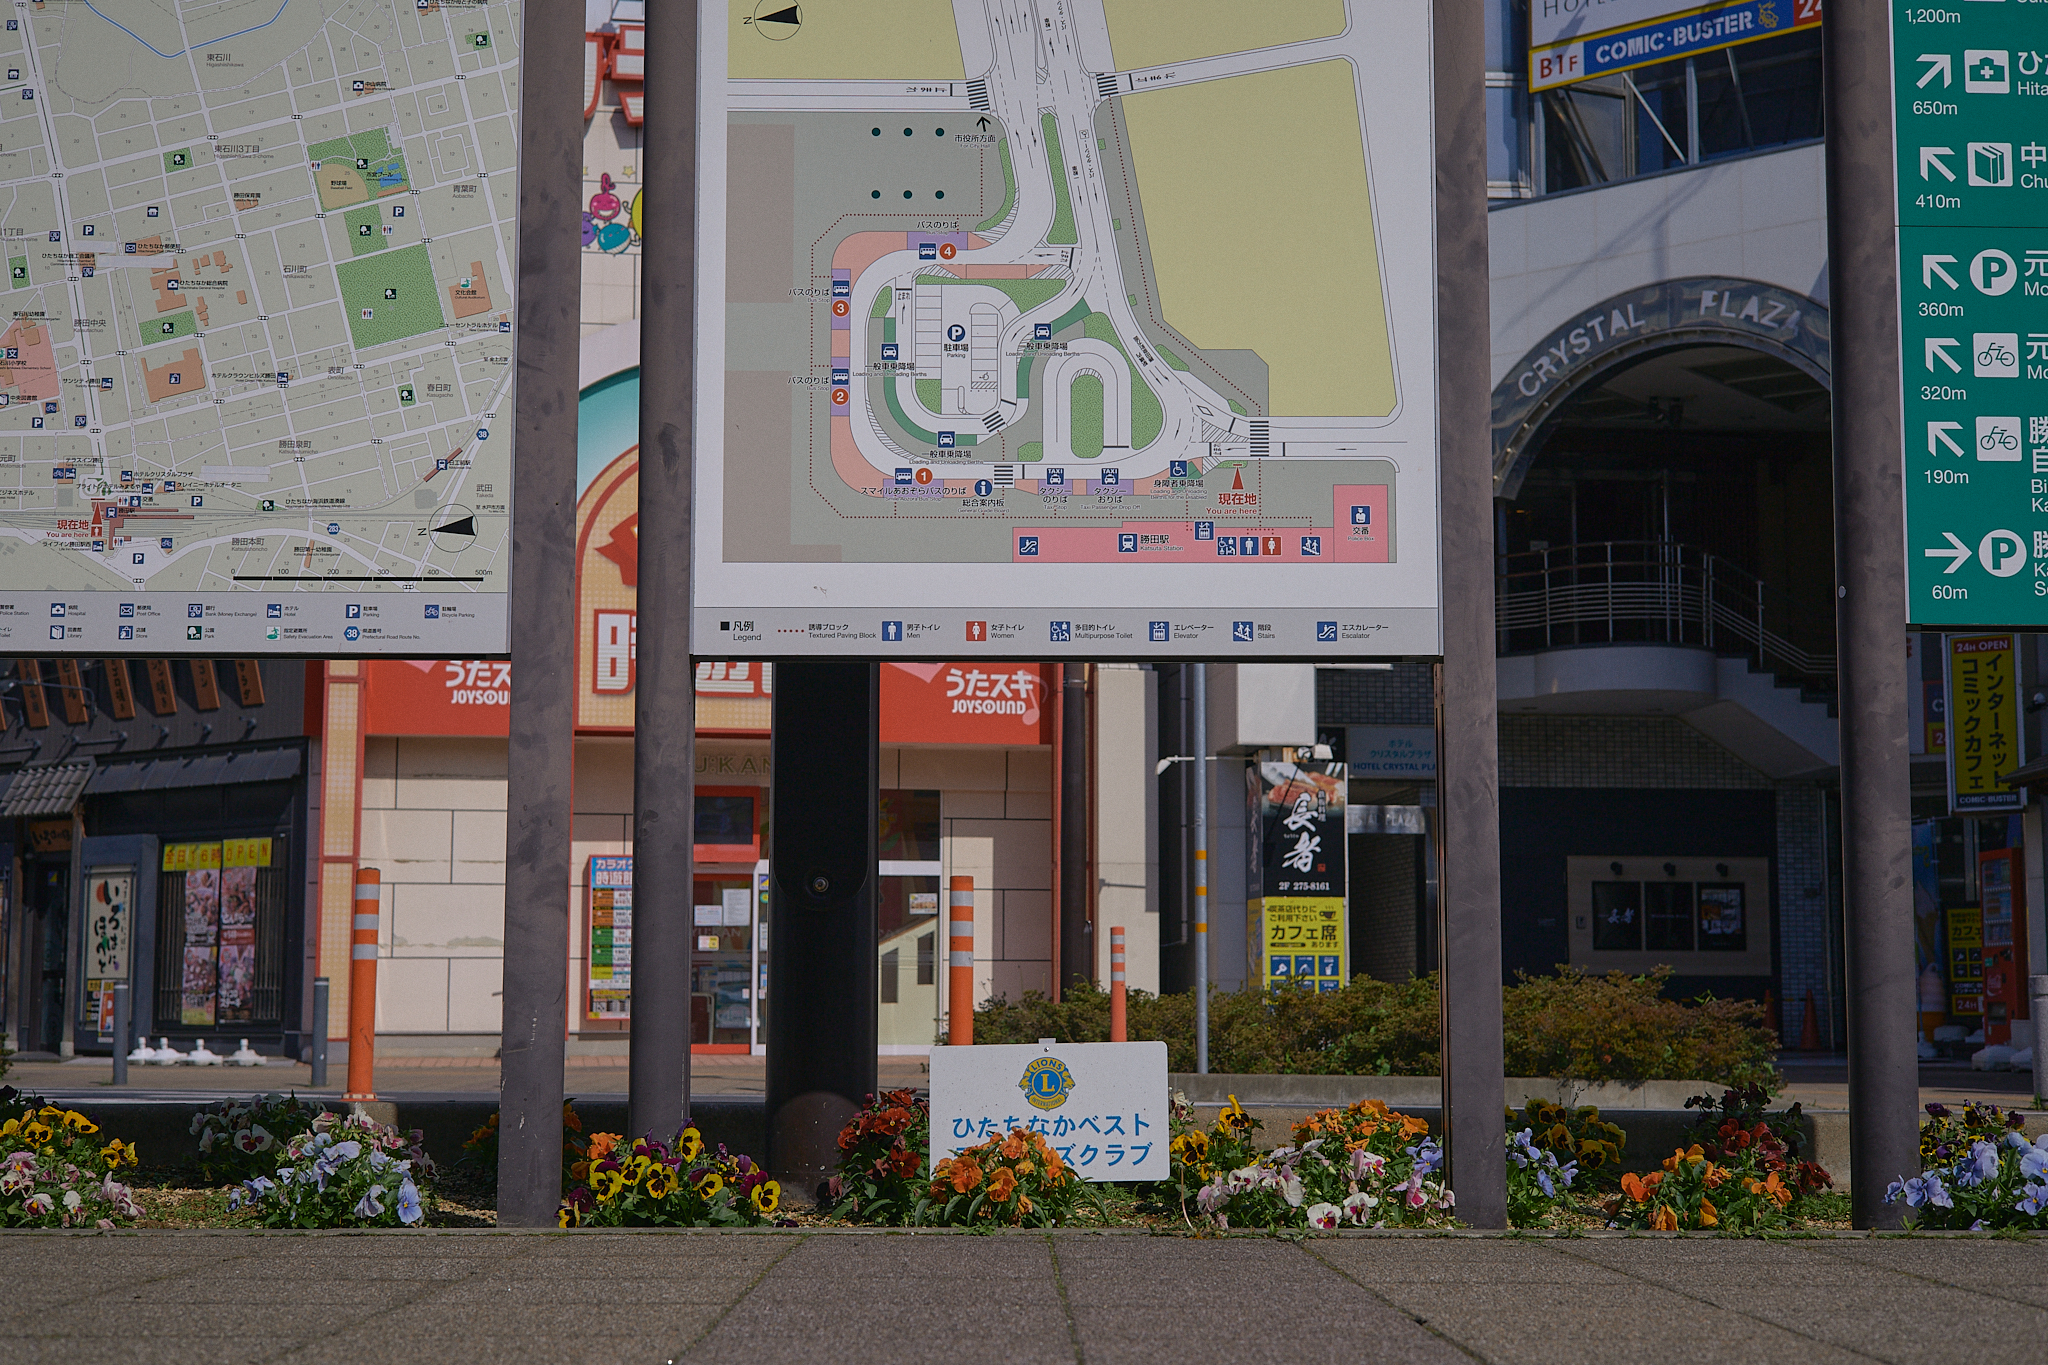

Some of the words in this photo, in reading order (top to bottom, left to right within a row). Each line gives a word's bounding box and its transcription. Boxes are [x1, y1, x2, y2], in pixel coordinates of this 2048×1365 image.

[1905, 9, 1961, 25] 1,200m
[206, 53, 231, 62] 東石川
[1540, 54, 1578, 79] B1F
[1912, 101, 1958, 115] 650m
[954, 134, 996, 143] 市役所方面
[214, 144, 260, 153] 東石川3丁目
[2021, 141, 2047, 169] 中
[453, 185, 478, 194] 青葉町
[1915, 194, 1961, 209] 410m
[917, 220, 958, 229] バスのりば
[943, 246, 952, 256] 4
[283, 265, 308, 274] 石川町
[788, 288, 830, 296] バスのりば
[837, 304, 845, 313] 3
[1918, 302, 1964, 317] 360m
[74, 319, 107, 327] 勝田中央
[943, 343, 969, 352] 駐車場
[1518, 303, 1646, 397] CRYSTAL
[1700, 289, 1802, 337] PLAZA
[328, 366, 344, 376] 表町
[787, 377, 829, 385] バスのりば
[427, 383, 452, 393] 春日町
[837, 392, 844, 401] 2
[1921, 386, 1967, 400] 320m
[478, 430, 487, 438] 38
[279, 440, 312, 449] 勝田泉町
[921, 450, 972, 459] 一般車乗降場
[920, 471, 928, 481] 1
[1924, 469, 1969, 484] 190m
[476, 484, 493, 492] 武田
[1153, 479, 1204, 488] 身障者乗降場
[860, 487, 967, 495] スマイルあおぞらバスのりば
[1039, 487, 1072, 495] タクシー
[1094, 487, 1127, 495] タクシー
[962, 499, 1005, 507] 総合案内板
[1042, 495, 1068, 504] のりば
[1097, 495, 1123, 504] おりば
[1218, 493, 1257, 506] 現在地
[1206, 507, 1220, 515] You
[1239, 507, 1257, 515] here
[57, 519, 89, 530] 現在地
[328, 525, 339, 533] 283
[1352, 527, 1369, 535] 交番
[231, 537, 265, 546] 勝田本町
[1140, 534, 1169, 544] 勝田駅
[1932, 585, 1968, 600] 60m
[732, 621, 754, 632] 凡例
[808, 623, 849, 631] 誘導ブロック
[907, 623, 941, 631] 男子トイレ
[733, 633, 762, 642] Legend
[836, 632, 858, 640] Paving
[1075, 632, 1114, 640] Multipurpose
[1956, 643, 1976, 653] 24H
[1978, 639, 2009, 651] OPEN
[946, 668, 1033, 699] うたスキ
[951, 699, 1027, 715] JOYSOUND
[1962, 658, 1984, 790] コミックカフェ
[1986, 653, 2008, 789] インターネット
[1353, 762, 1381, 770] HOTEL
[1383, 762, 1420, 770] CRYSTAL
[165, 846, 221, 865] 全日16時
[226, 844, 268, 862] OPEN
[1278, 882, 1291, 891] 2F
[1293, 882, 1331, 891] 275-8161
[1269, 914, 1317, 922] ご利用下さい
[1271, 925, 1337, 941] カフェ席
[1311, 941, 1339, 949] あります
[1030, 1059, 1064, 1072] LIONS
[1040, 1073, 1056, 1093] L
[952, 1113, 1150, 1139] ひたちなかベスト
